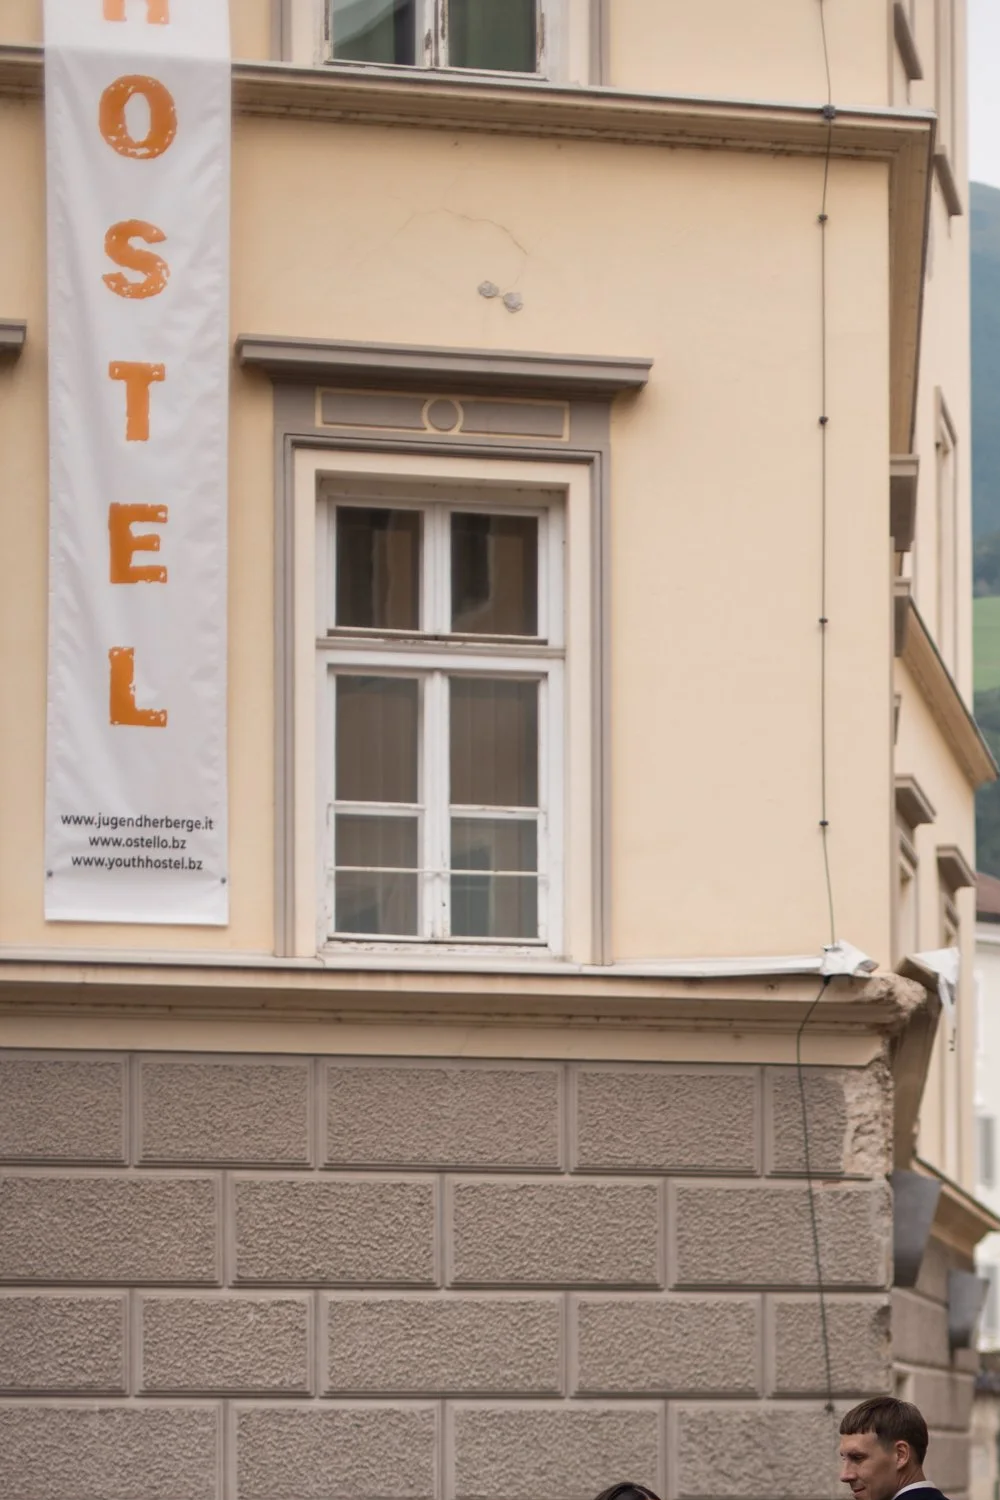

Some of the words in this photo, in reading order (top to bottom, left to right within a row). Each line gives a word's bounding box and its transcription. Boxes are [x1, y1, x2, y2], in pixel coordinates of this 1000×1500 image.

[61, 813, 214, 832] www.jugendherberge.it
[89, 835, 187, 850] www.ostello.bz
[71, 855, 204, 871] www.youthhostel.bz
